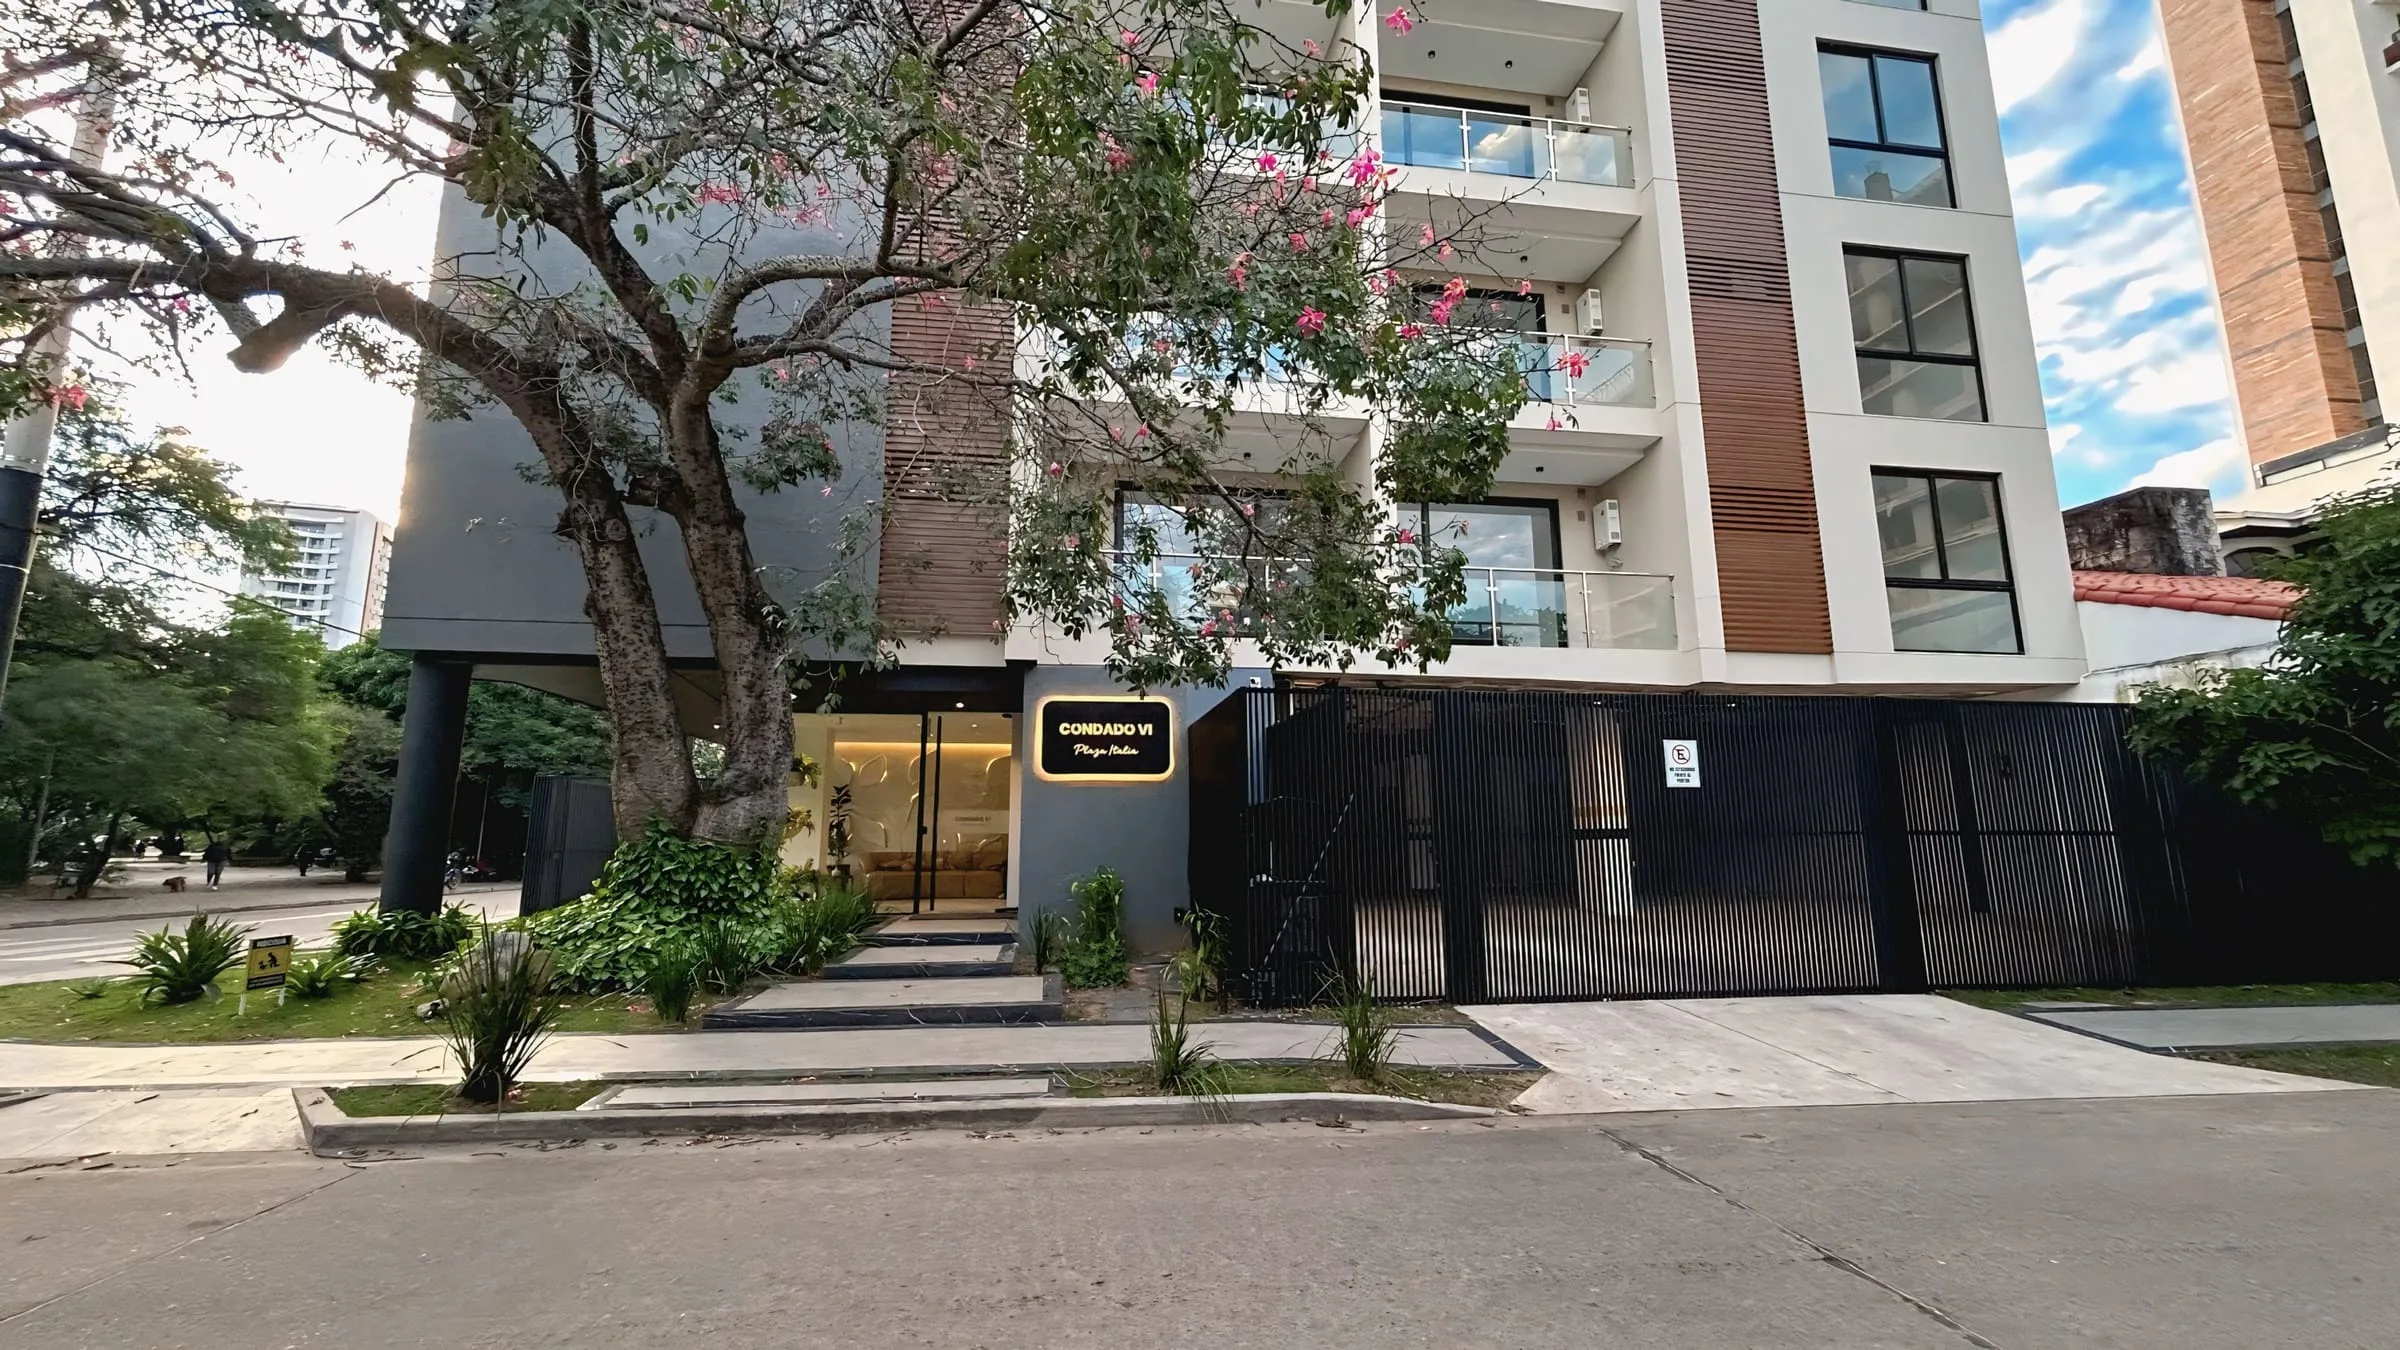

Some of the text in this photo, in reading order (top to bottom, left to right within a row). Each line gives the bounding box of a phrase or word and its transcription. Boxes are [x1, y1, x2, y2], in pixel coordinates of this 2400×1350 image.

[1059, 723, 1153, 736] CONDADO VI
[1073, 743, 1139, 758] Plaza Italia
